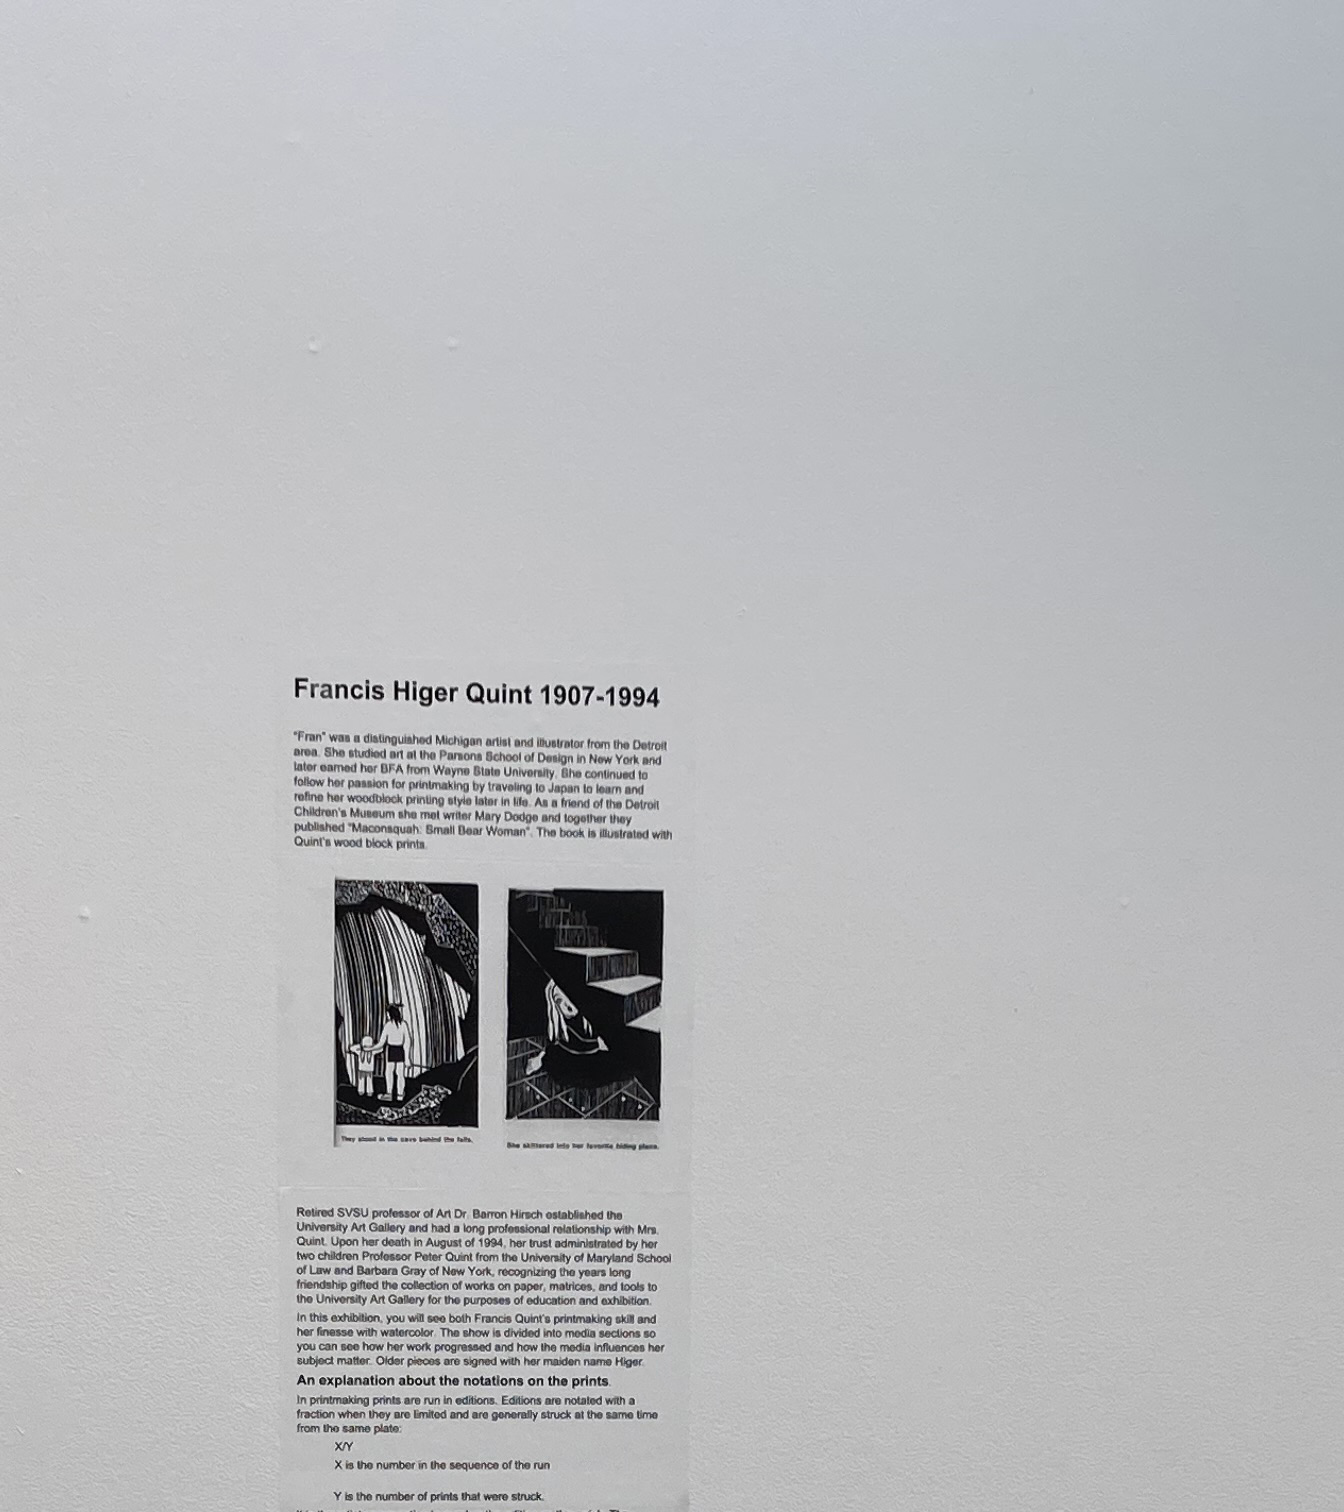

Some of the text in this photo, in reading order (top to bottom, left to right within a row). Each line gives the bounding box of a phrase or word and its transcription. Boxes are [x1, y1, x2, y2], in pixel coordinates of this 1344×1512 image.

[294, 677, 659, 708] Francis Higer Quint 1907-1994
[293, 730, 667, 751] "Fran" was a distinguished Michigan artist and illustrator from the Detroit
[296, 1206, 334, 1217] Retired
[336, 1207, 369, 1218] SVSU
[371, 1207, 420, 1220] professor
[422, 1208, 434, 1218] of
[435, 1208, 451, 1218] Art
[472, 1208, 508, 1219] Barron
[509, 1209, 543, 1219] Hirsch
[545, 1209, 604, 1220] established
[606, 1210, 623, 1220] the
[296, 1293, 652, 1307] the University Art Gallery for the purposes of education and exhibition.
[296, 1374, 315, 1385] An
[318, 1374, 395, 1388] explanation
[398, 1374, 436, 1386] about
[438, 1374, 459, 1386] the
[463, 1374, 524, 1386] notations
[527, 1377, 544, 1386] on
[547, 1375, 568, 1386] the
[296, 1394, 635, 1407] In printmaking prints are run in editions. Editions are notated with a
[334, 1441, 353, 1451] X/Y
[334, 1459, 550, 1472] X is the number in the sequence of the run
[333, 1491, 544, 1503] Y is the number of prints that were struck.
